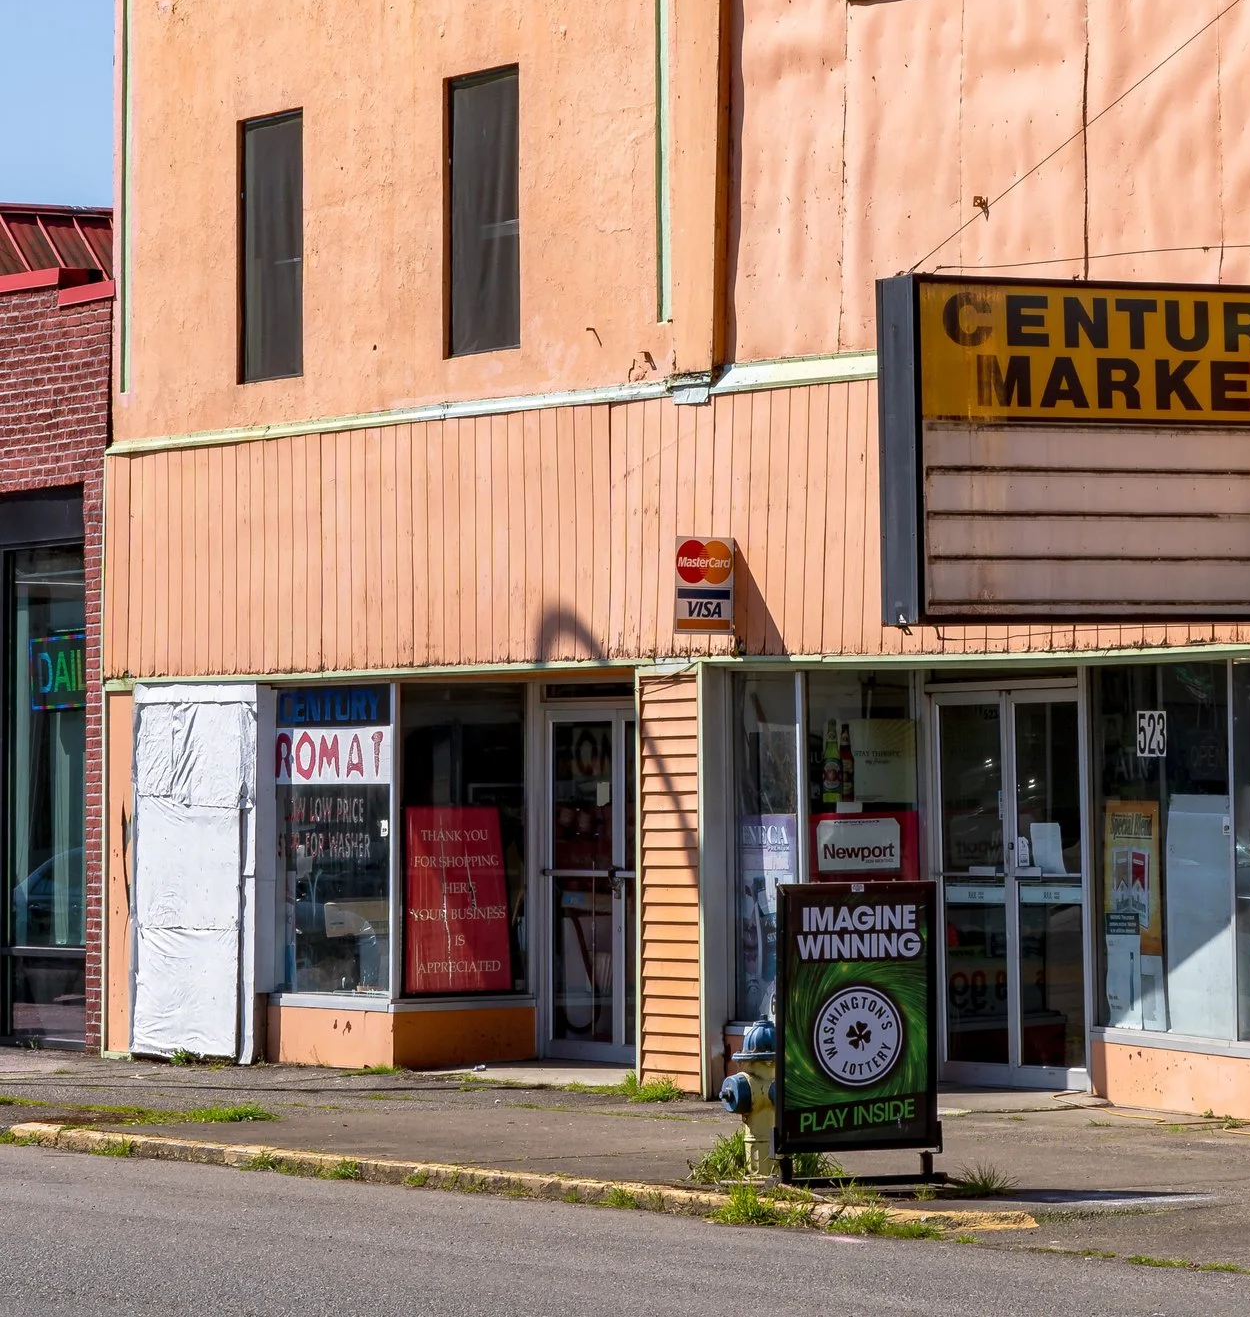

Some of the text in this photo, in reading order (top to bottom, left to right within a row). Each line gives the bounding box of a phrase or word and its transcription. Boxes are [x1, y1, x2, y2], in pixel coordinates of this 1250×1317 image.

[677, 556, 731, 569] MasterCard
[687, 600, 723, 618] VISA
[279, 688, 381, 723] CENTURY
[1138, 712, 1166, 755] 523
[310, 797, 333, 823] LOW
[337, 797, 364, 824] PRICE
[328, 832, 371, 859] WASHER
[420, 829, 488, 842] THANK YOU
[414, 854, 499, 868] FOR SHOPPING
[823, 842, 895, 862] Newport
[442, 881, 477, 894] HERE
[411, 906, 506, 922] YOUR BUSINESS
[802, 904, 916, 932] IMAGINE
[455, 935, 466, 946] IS
[797, 931, 921, 960] WINNING
[417, 960, 501, 975] APPRECIATED
[823, 996, 893, 1061] WASHINGTON'S
[841, 1041, 892, 1076] LOTTERY
[800, 1098, 915, 1133] PLAY INSIDE
